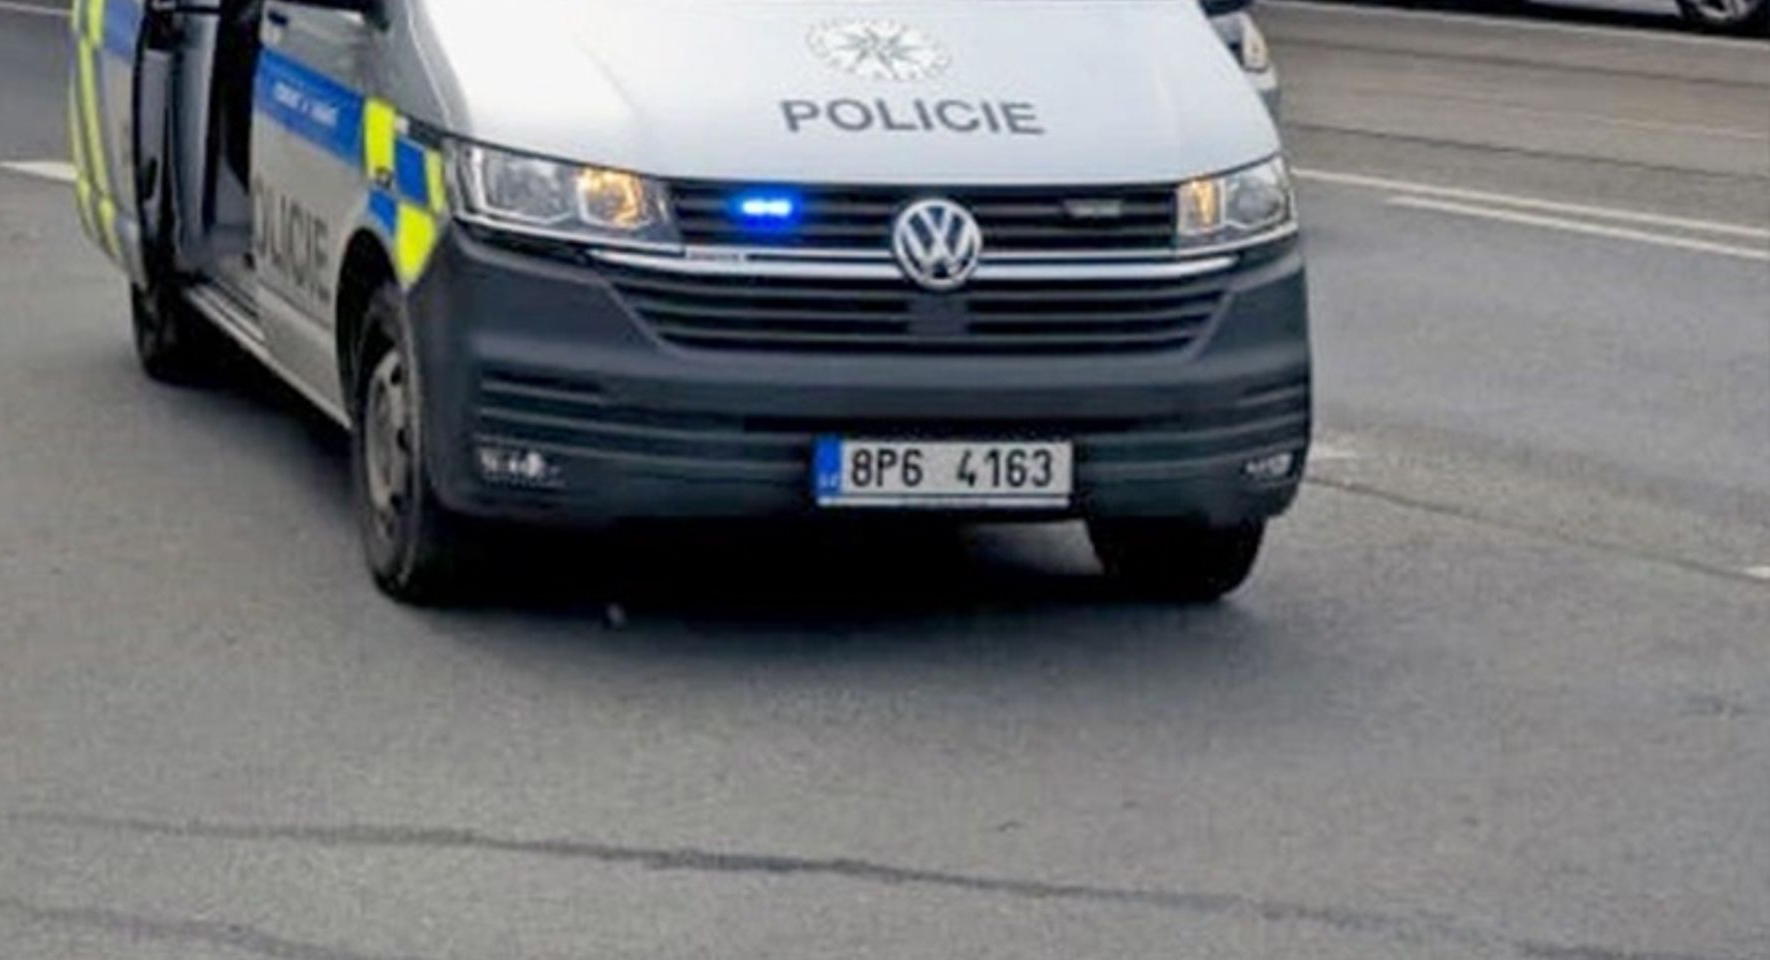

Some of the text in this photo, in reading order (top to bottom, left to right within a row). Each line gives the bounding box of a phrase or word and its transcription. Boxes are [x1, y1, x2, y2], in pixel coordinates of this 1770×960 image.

[781, 98, 1046, 135] POLICIE
[850, 448, 924, 488] 8P6
[956, 448, 1053, 488] 4163
